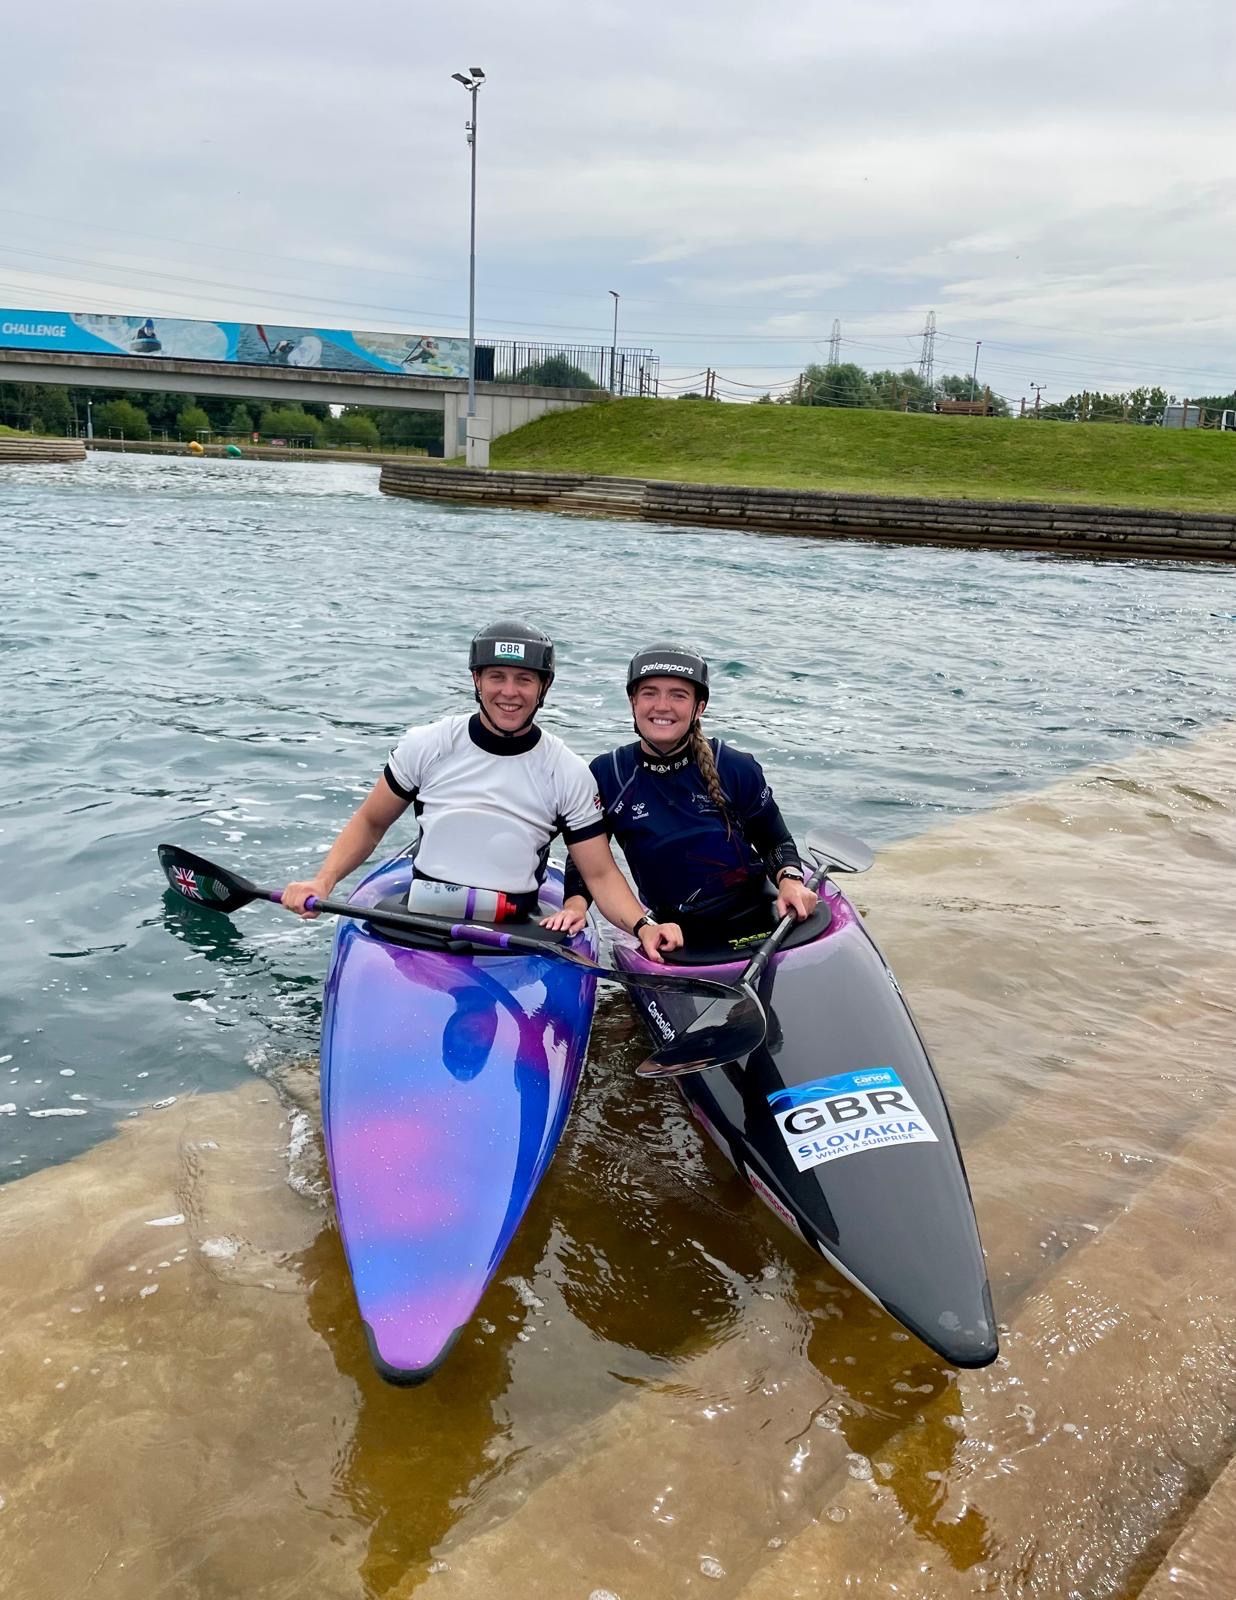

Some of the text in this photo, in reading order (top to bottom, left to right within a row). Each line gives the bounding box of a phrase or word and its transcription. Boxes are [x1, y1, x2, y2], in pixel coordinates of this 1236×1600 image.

[2, 322, 67, 338] CHALLENGE
[500, 643, 520, 654] GBR
[640, 662, 695, 675] galasport
[648, 1000, 676, 1042] Carboligh
[853, 1073, 892, 1084] canoe
[784, 1090, 915, 1136] GBR
[798, 1121, 925, 1159] SLOVAKIA
[815, 1132, 916, 1161] WHAT A SURPRISE
